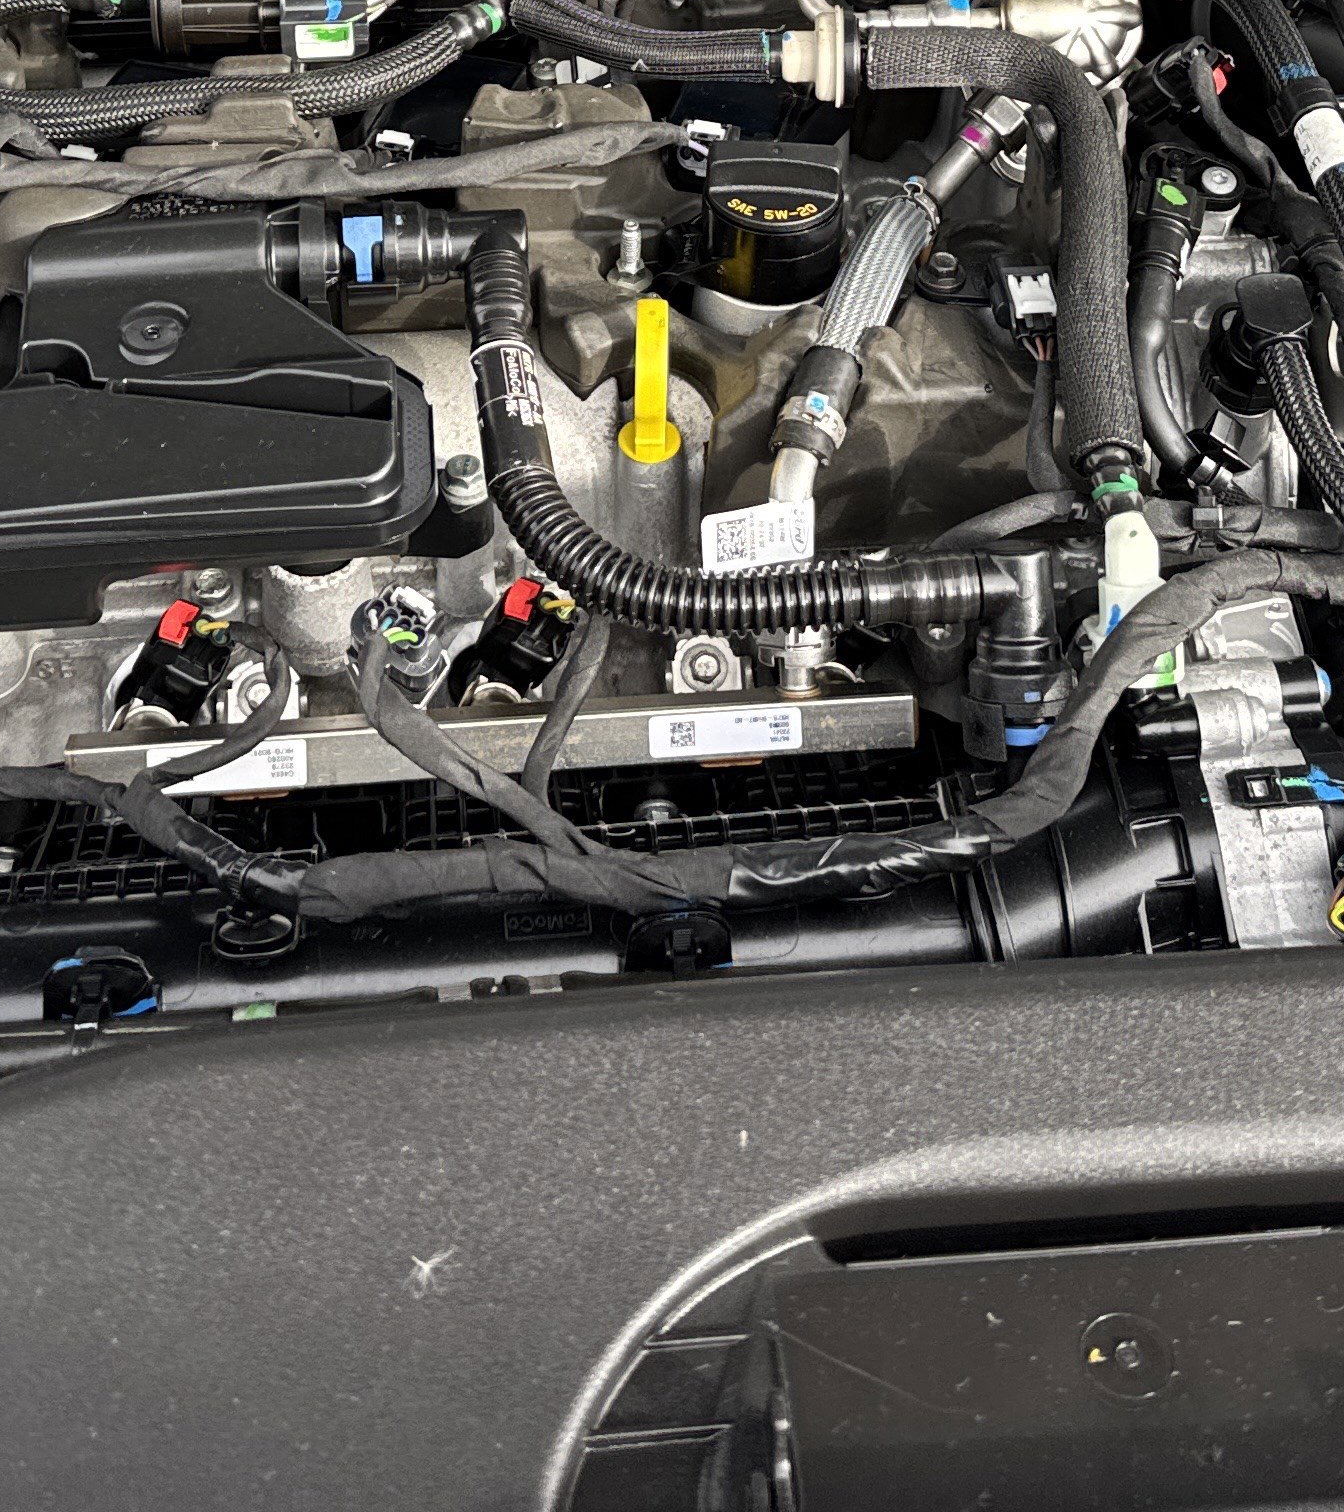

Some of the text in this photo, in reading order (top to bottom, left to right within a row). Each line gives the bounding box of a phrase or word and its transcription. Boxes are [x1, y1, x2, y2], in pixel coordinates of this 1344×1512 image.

[727, 198, 818, 221] SAE 5W-20
[504, 347, 522, 395] FoMoCo
[508, 913, 587, 933] FoMoCo
